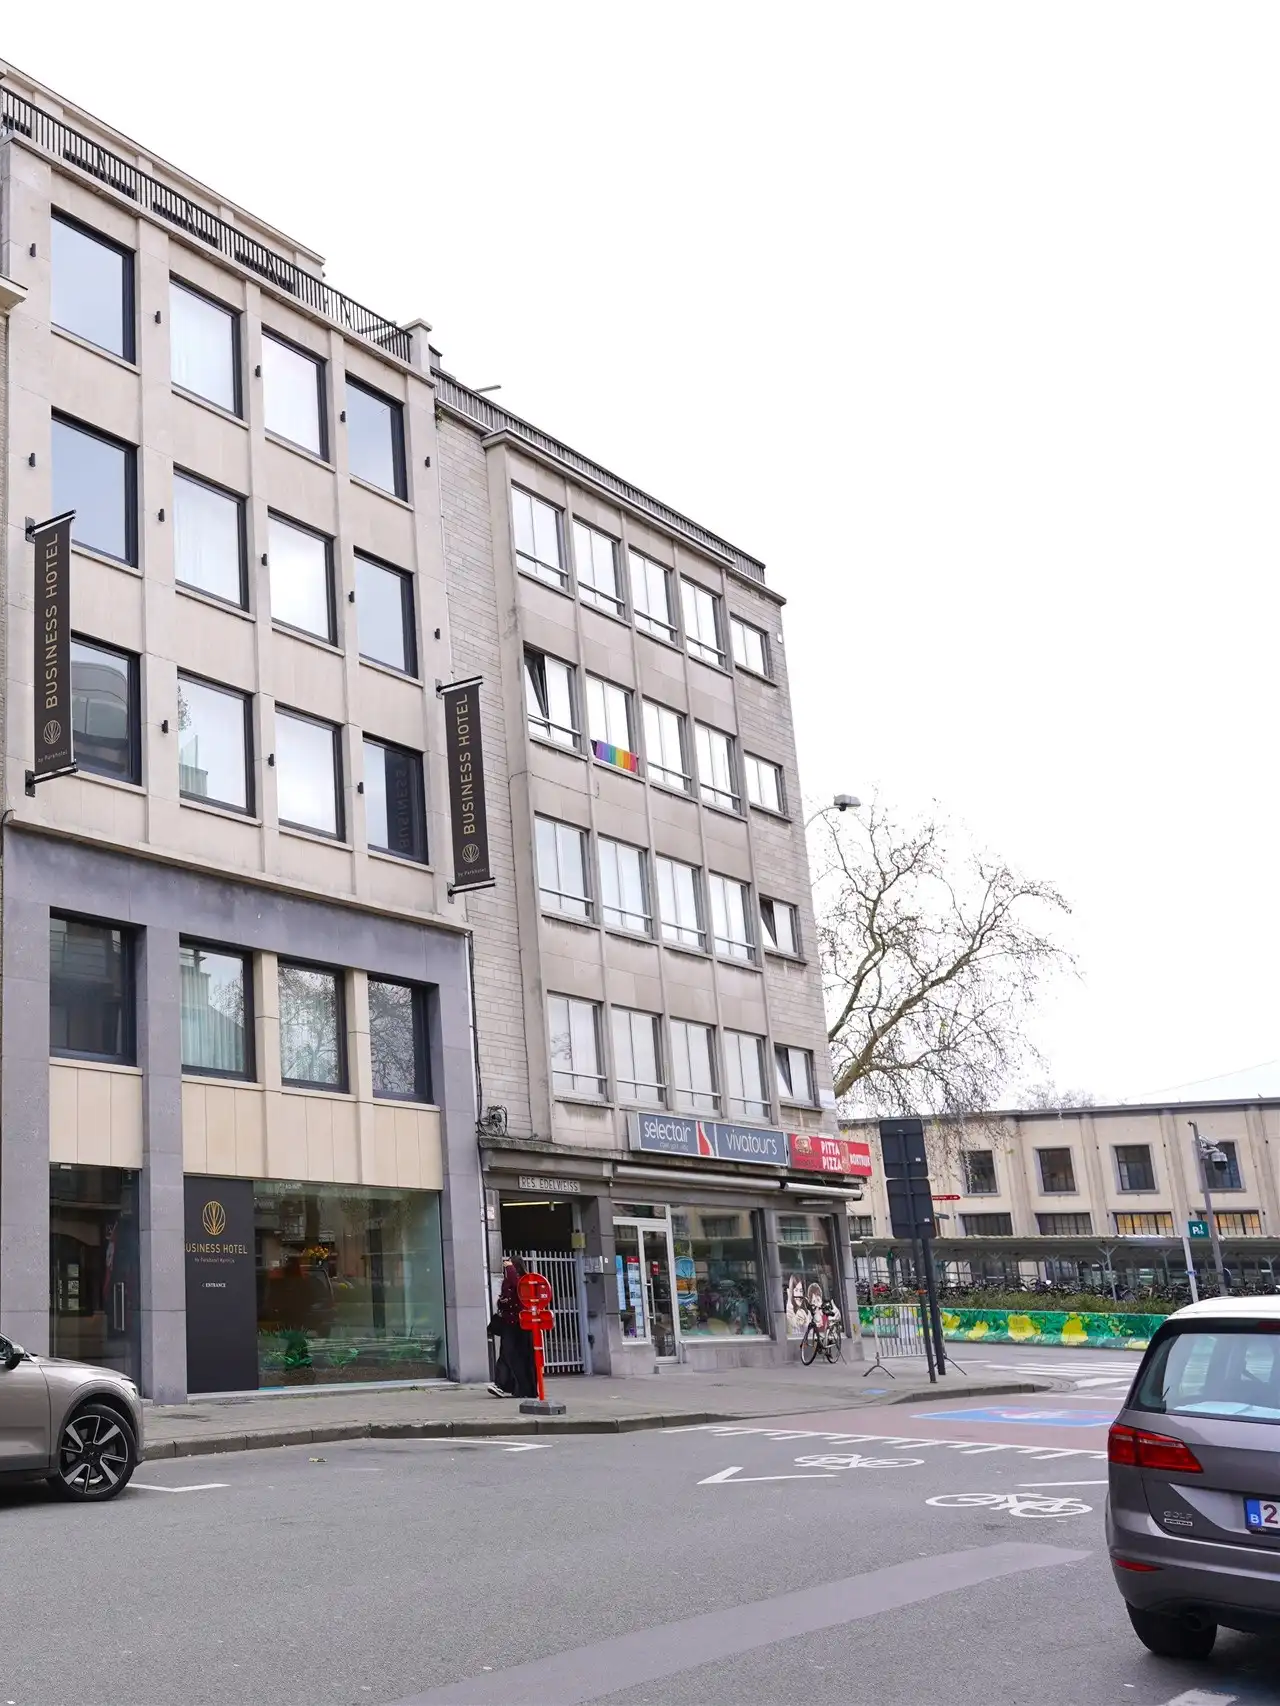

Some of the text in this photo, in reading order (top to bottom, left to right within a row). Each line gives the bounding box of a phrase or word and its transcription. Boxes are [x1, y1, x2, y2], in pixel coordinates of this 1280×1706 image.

[45, 533, 59, 709] BUSINESS HOTEL
[456, 694, 476, 835] BUSINESS HOTEL
[644, 1118, 692, 1142] selectair
[725, 1129, 778, 1156] vivatours
[821, 1140, 840, 1156] PITTA
[822, 1156, 843, 1171] PIZZA
[540, 1178, 579, 1192] EDELWEISS
[185, 1243, 248, 1255] USINESS HOTEL
[1250, 1514, 1260, 1524] B
